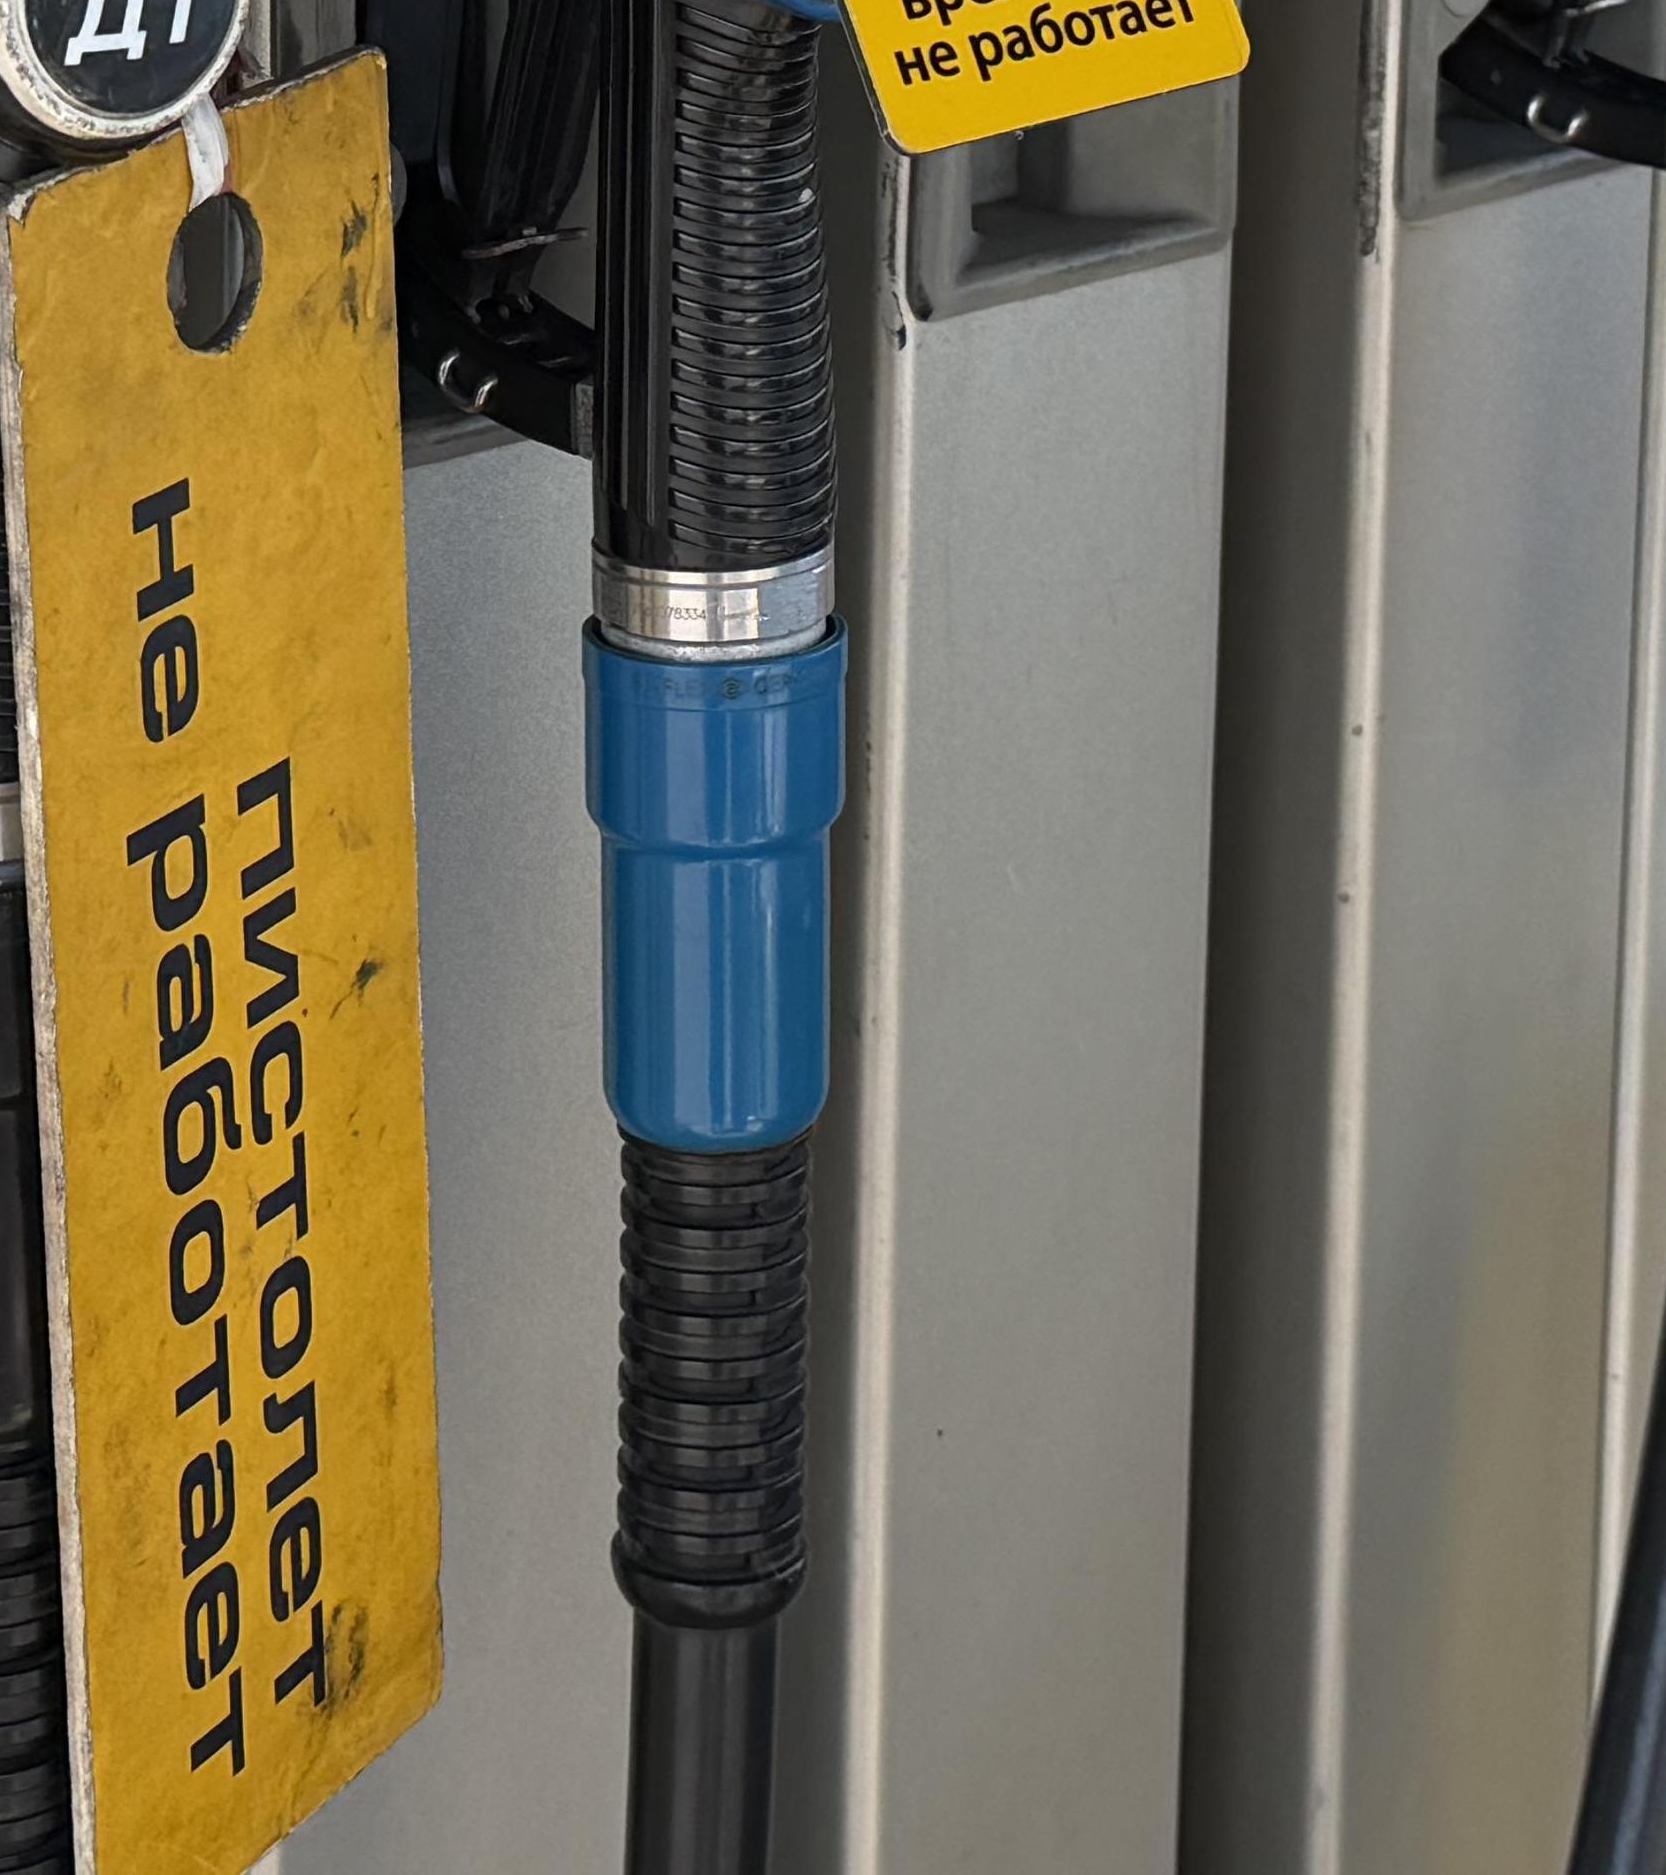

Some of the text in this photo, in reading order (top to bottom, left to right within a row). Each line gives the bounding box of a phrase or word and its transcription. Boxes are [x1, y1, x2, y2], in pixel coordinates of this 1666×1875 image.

[893, 39, 961, 86] не
[125, 792, 246, 1777] работает
[236, 755, 328, 1708] пистолет
